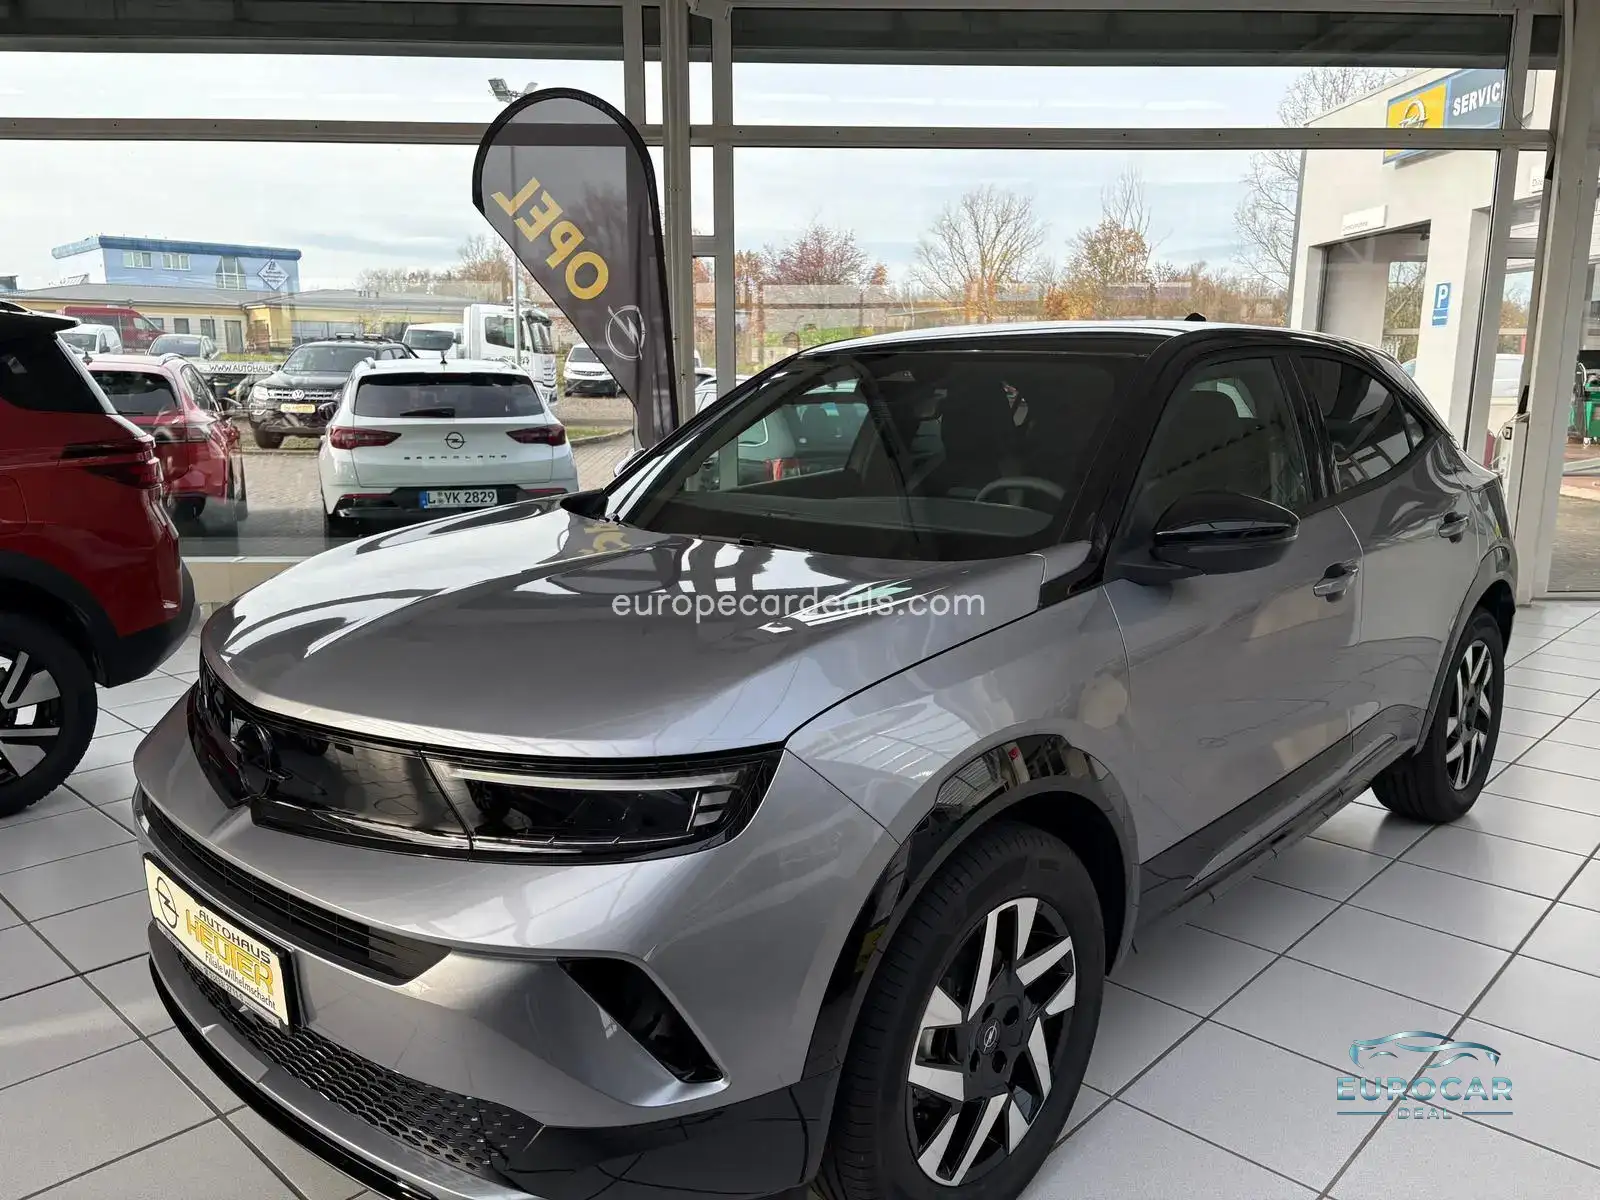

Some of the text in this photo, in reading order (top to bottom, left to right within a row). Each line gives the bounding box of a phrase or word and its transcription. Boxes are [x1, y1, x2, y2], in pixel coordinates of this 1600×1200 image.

[1436, 284, 1449, 309] P
[444, 491, 460, 503] YK
[464, 490, 496, 503] 2829
[199, 909, 271, 965] AUTOHAUS
[205, 951, 223, 974] Filiale
[223, 964, 276, 1011] Wilhelmschacht
